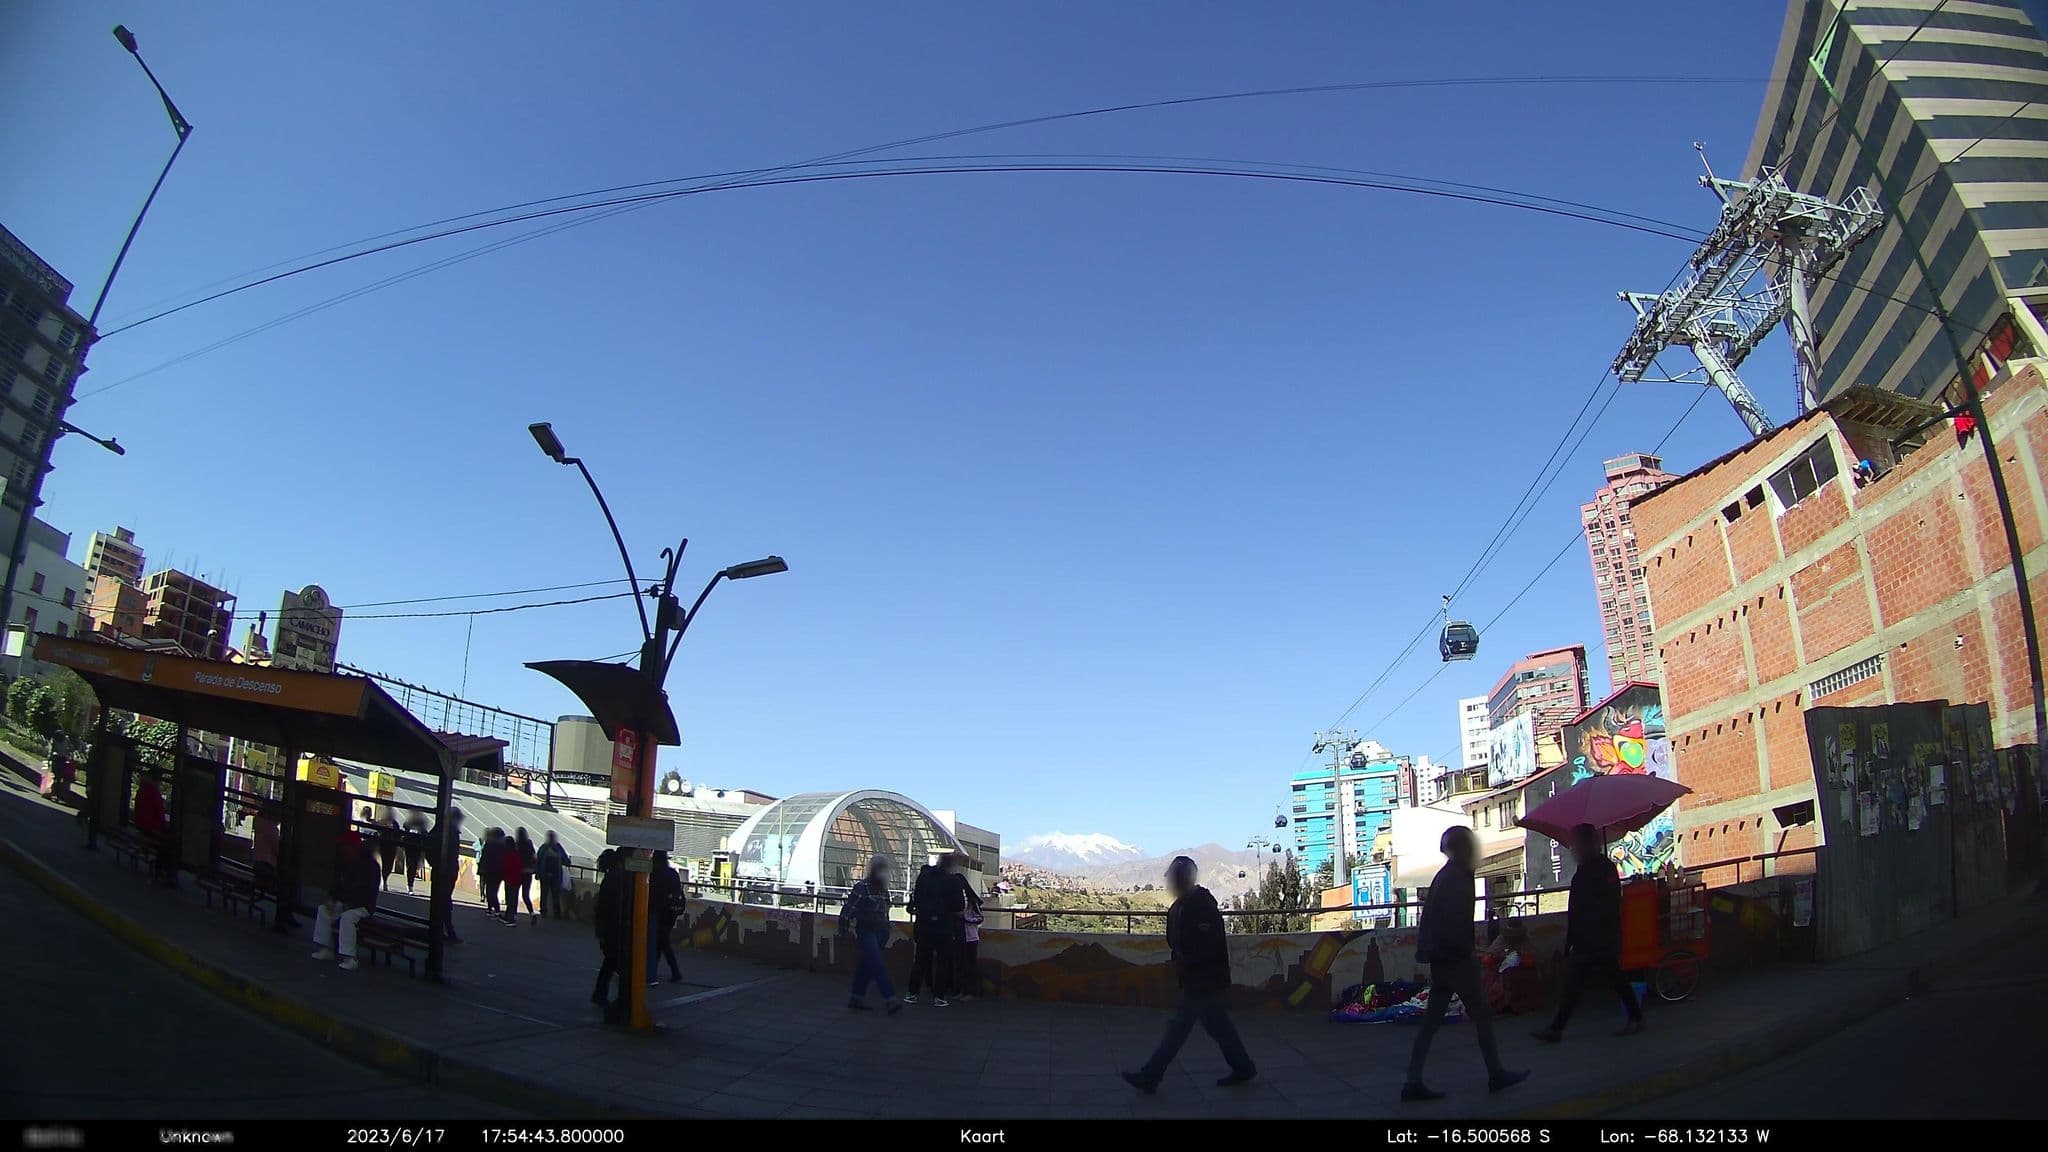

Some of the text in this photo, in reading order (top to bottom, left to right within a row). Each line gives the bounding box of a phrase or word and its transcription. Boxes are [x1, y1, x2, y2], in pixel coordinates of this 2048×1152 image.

[290, 617, 330, 636] CAMACHO
[194, 671, 282, 694] Parada de Descenso
